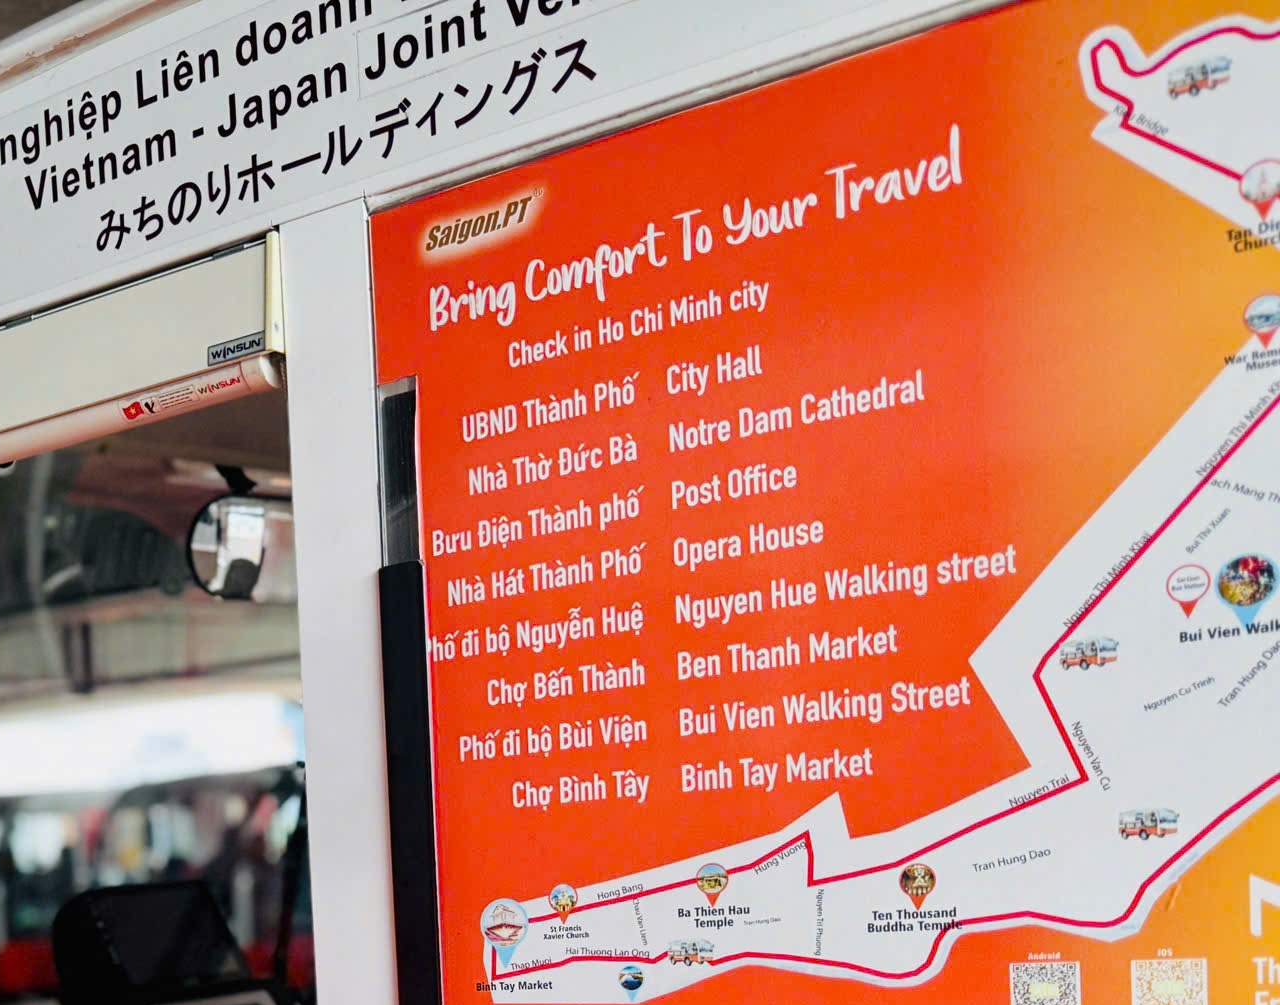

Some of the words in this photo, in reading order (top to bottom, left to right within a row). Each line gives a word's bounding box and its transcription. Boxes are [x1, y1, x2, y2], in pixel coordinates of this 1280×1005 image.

[0, 87, 122, 166] nghiệp
[135, 48, 219, 110] Liên
[24, 128, 177, 211] Vietnam
[218, 62, 348, 138] Japan
[365, 3, 487, 80] Joint
[1136, 113, 1169, 137] Bridge
[96, 39, 597, 251] みちのりホールディングス
[424, 195, 533, 254] Saigon.PT
[429, 281, 517, 331] Bring
[524, 222, 666, 303] Comfort
[674, 208, 713, 261] To
[723, 190, 817, 247] Your
[824, 123, 963, 219] Travel
[1226, 226, 1253, 243] Tan
[508, 328, 568, 368] Check
[572, 324, 593, 351] in
[597, 316, 625, 344] Ho
[629, 303, 664, 337] Chi
[669, 294, 722, 329] Minh
[729, 280, 770, 317] city
[211, 338, 261, 360] WINSUN
[666, 361, 709, 397] City
[716, 346, 762, 383] Hall
[197, 376, 241, 395] WINSUN
[462, 403, 519, 443] UBND
[523, 388, 588, 433] Thành
[594, 369, 640, 409] Phố
[668, 417, 732, 453] Notre
[738, 403, 792, 438] Dam
[799, 369, 925, 425] Cathedral
[467, 459, 509, 495] Nhà
[512, 449, 553, 486] Thờ
[557, 440, 603, 478] Đức
[608, 433, 638, 463] Bà
[670, 477, 721, 511] Post
[727, 464, 798, 499] Office
[432, 529, 472, 557] Bưu
[477, 515, 523, 550] Điện
[528, 497, 592, 537] Thành
[600, 485, 645, 531] phố
[673, 535, 741, 569] Opera
[748, 521, 824, 556] House
[447, 575, 486, 607] Nhà
[491, 568, 525, 599] Hát
[529, 554, 594, 592] Thành
[601, 541, 647, 579] Phố
[675, 585, 765, 632] Nguyen
[770, 578, 817, 610] Hue
[823, 560, 929, 602] Walking
[935, 545, 1017, 585] street
[461, 628, 480, 658] đi
[485, 624, 510, 656] bộ
[516, 606, 595, 654] Nguyễn
[601, 601, 644, 636] Huệ
[677, 652, 721, 681] Ben
[726, 640, 802, 676] Thanh
[808, 624, 898, 664] Market
[1179, 628, 1202, 643] Bui
[1207, 626, 1240, 640] Vien
[486, 677, 528, 709] Chợ
[533, 666, 575, 701] Bến
[578, 657, 646, 696] Thành
[678, 706, 717, 737] Bui
[723, 698, 776, 731] Vien
[782, 686, 883, 729] Walking
[890, 676, 971, 714] Street
[1143, 692, 1178, 711] Nguyen
[1178, 686, 1191, 697] Cu
[1192, 675, 1215, 691] Trinh
[1217, 686, 1242, 708] Tran
[1238, 659, 1268, 688] Hung
[459, 728, 503, 763] Phố
[502, 727, 524, 758] đi
[527, 723, 554, 758] bộ
[558, 718, 595, 750] Bùi
[599, 714, 648, 749] Viện
[1071, 720, 1095, 759] Nguyen
[1089, 756, 1105, 778] Van
[1099, 776, 1111, 792] Cu
[511, 778, 554, 812] Chợ
[558, 770, 608, 804] Bình
[611, 765, 650, 802] Tây
[680, 761, 732, 794] Binh
[738, 756, 780, 793] Tay
[785, 747, 874, 785] Market
[1008, 784, 1049, 808] Nguyen
[754, 855, 779, 875] Hung
[778, 840, 808, 861] Vuong
[972, 861, 995, 872] Tran
[997, 853, 1027, 867] Hung
[1028, 848, 1051, 860] Dao
[597, 888, 620, 900] Hong
[622, 882, 644, 895] Bang
[677, 907, 691, 918] Ba
[694, 906, 725, 917] Thien
[728, 905, 750, 915] Hau
[815, 888, 825, 916] Nguyen
[872, 910, 893, 921] Ten
[896, 906, 957, 920] Thousand
[543, 932, 565, 941] Xavier
[566, 931, 589, 940] Church
[559, 925, 582, 933] Francis
[694, 917, 734, 930] Temple
[813, 928, 824, 956] Phuong
[867, 921, 913, 933] Buddha
[917, 919, 963, 932] Temple
[565, 947, 579, 955] Hai
[581, 948, 612, 957] Thuong
[614, 948, 629, 957] Lan
[476, 982, 496, 992] Binh
[499, 981, 515, 993] Tay
[518, 980, 553, 992] Market
